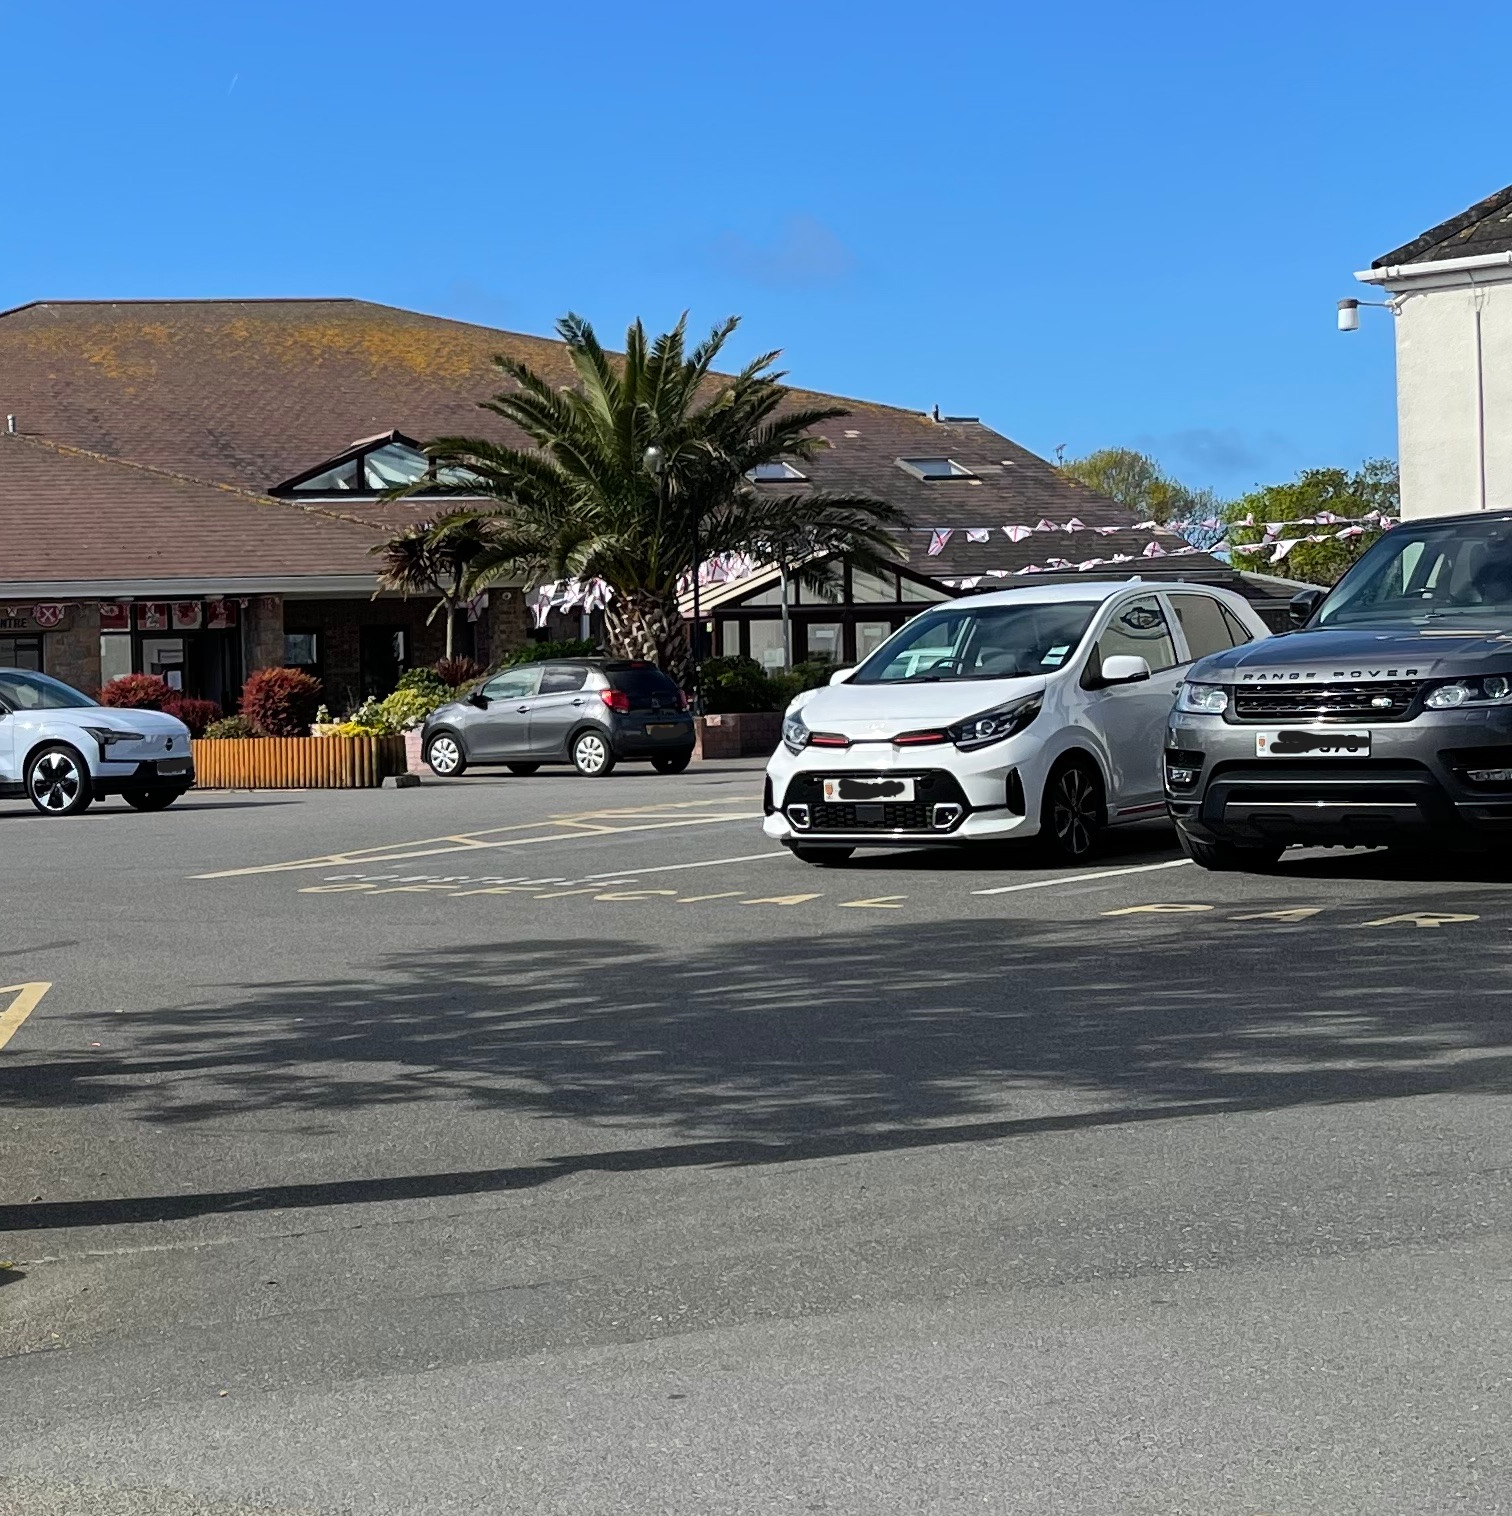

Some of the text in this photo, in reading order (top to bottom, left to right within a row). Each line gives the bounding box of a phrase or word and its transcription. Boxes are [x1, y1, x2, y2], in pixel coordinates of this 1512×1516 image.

[1243, 669, 1418, 680] RANGE ROVER
[298, 884, 1512, 931] OFFICIAL PAR
